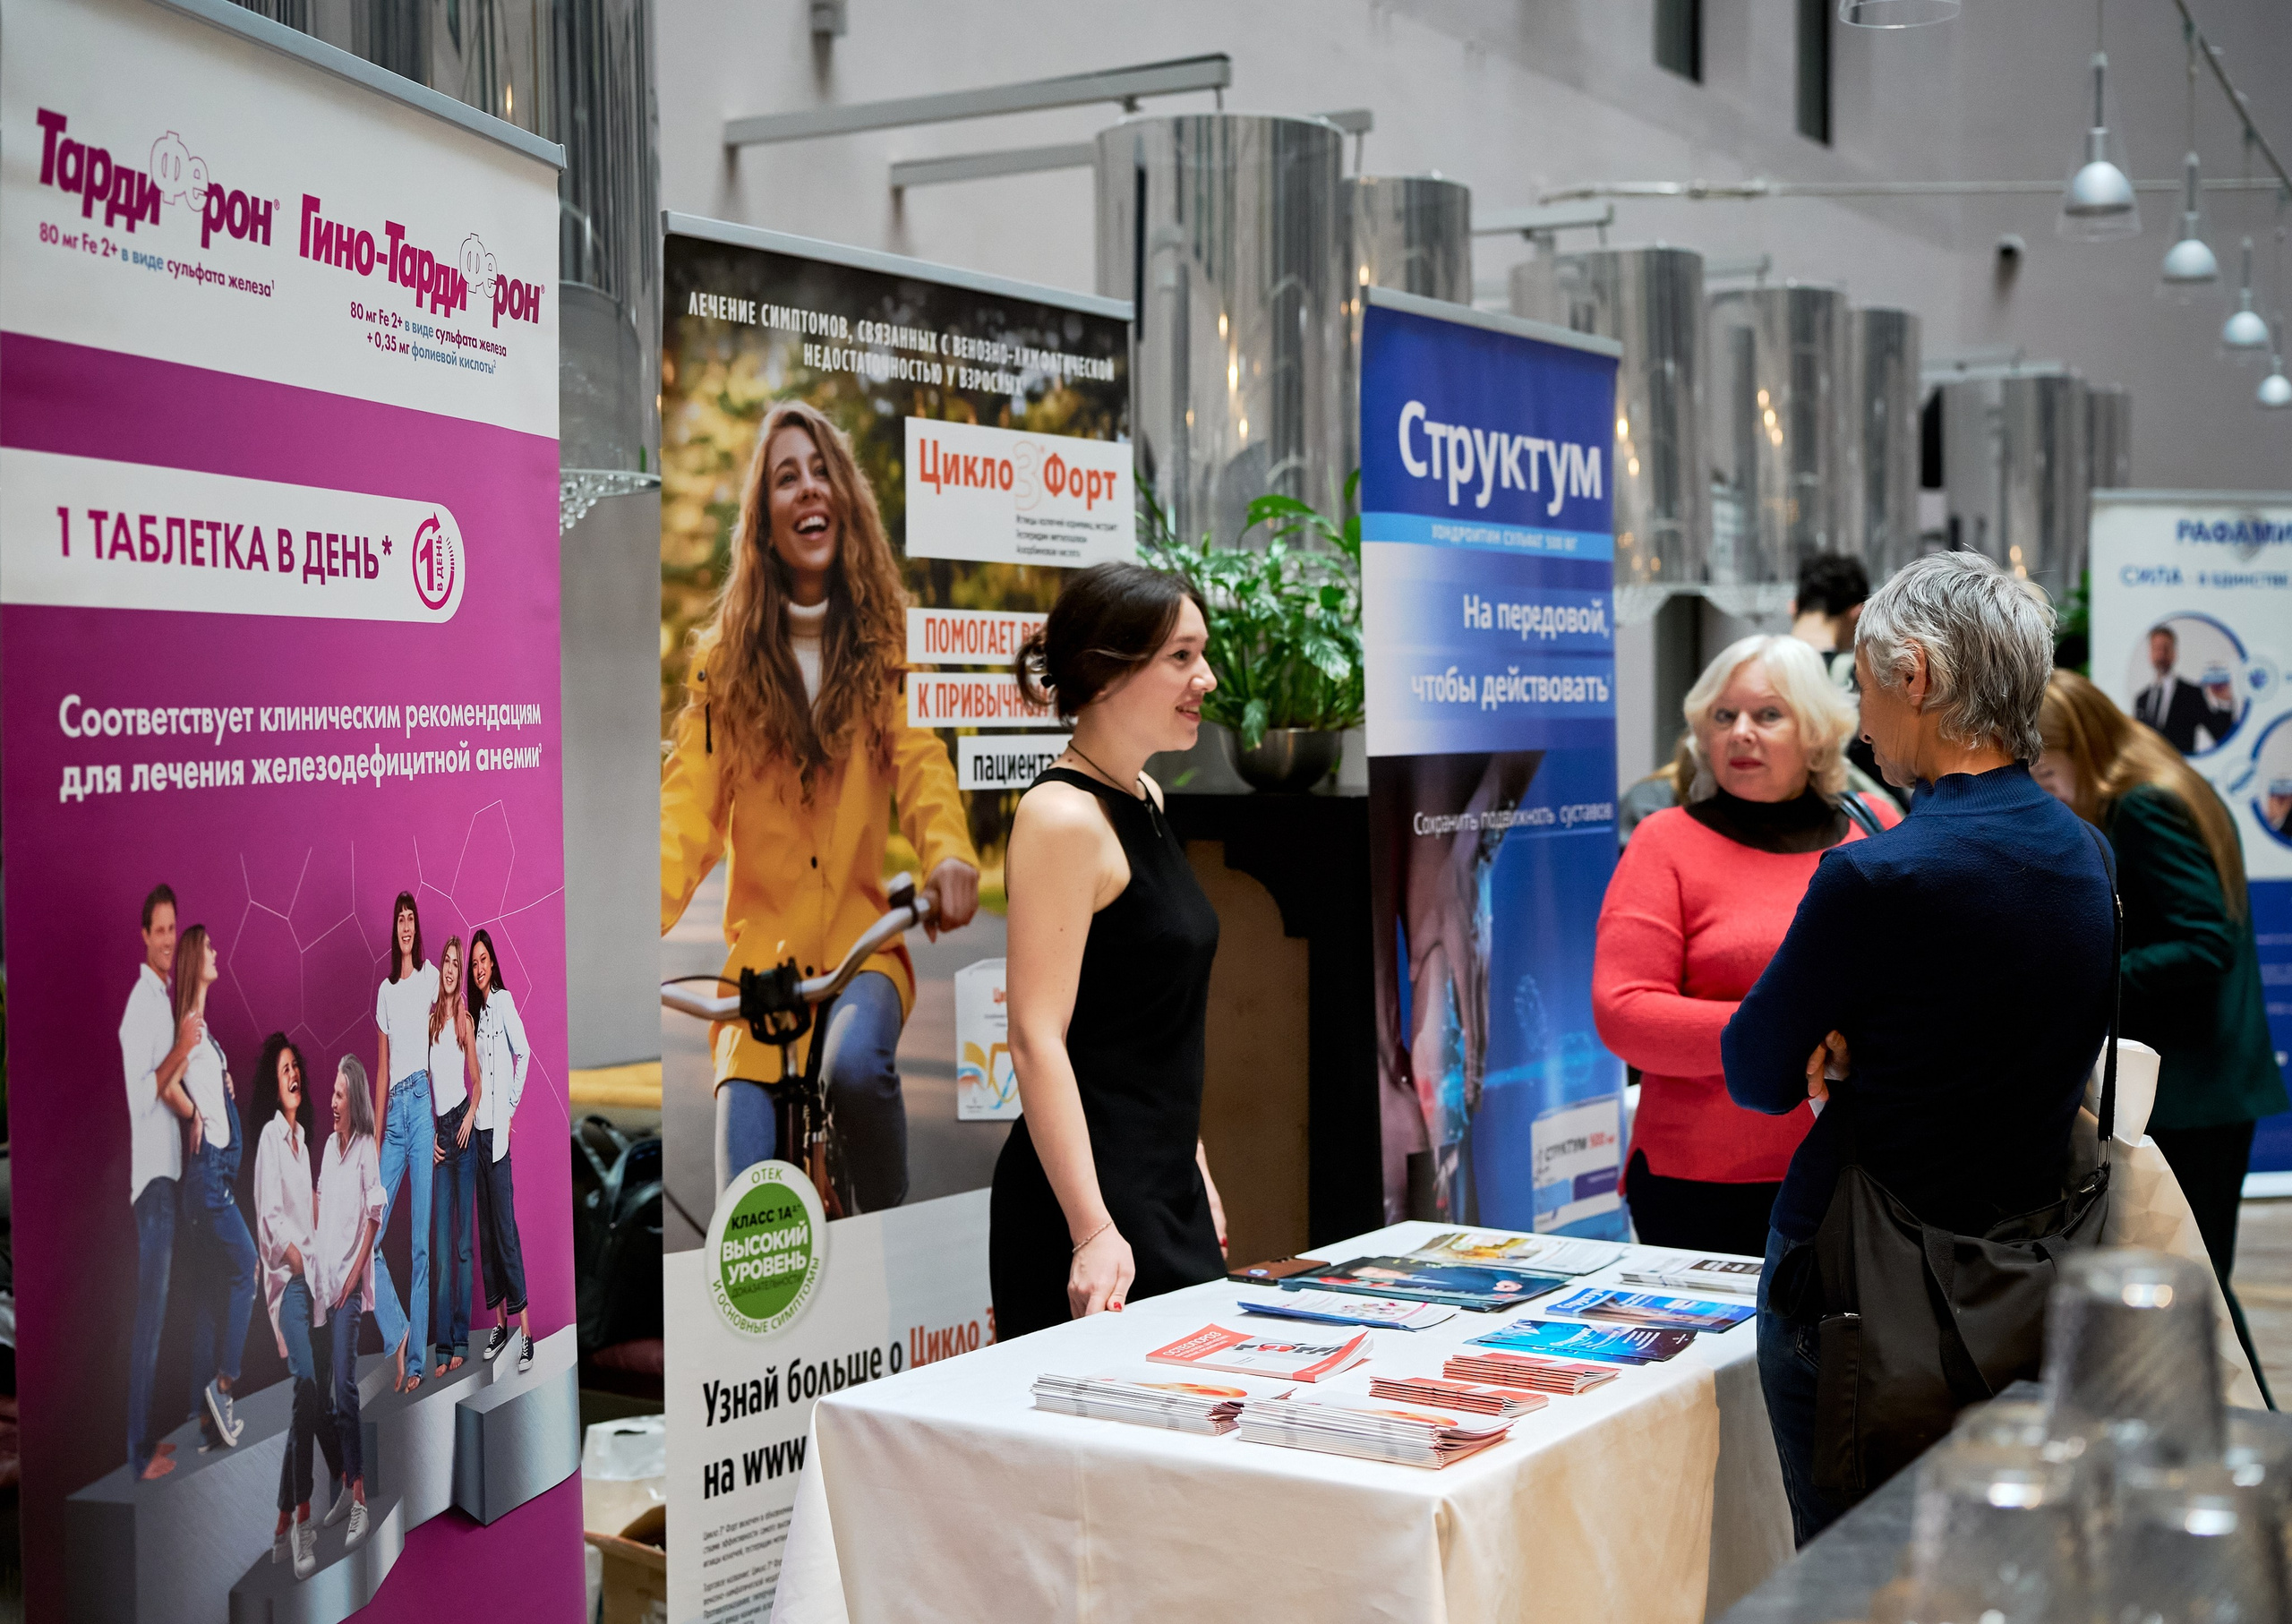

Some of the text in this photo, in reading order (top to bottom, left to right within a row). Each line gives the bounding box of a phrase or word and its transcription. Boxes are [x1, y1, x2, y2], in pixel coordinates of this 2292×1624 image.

[39, 222, 59, 244] 80
[62, 234, 78, 250] мг
[81, 233, 98, 254] Fe
[101, 237, 118, 257] 2+
[121, 248, 129, 261] в
[132, 251, 164, 271] виде
[167, 260, 226, 286] сульфата
[350, 302, 507, 357] 80 мг Fe 2+ в виде сульфата железа
[688, 292, 757, 324] ЛЕЧЕНИЕ
[761, 304, 853, 344] СИМПТОМОВ,
[857, 320, 937, 354] СВЯЗАННЫХ
[941, 334, 949, 355] С
[374, 331, 397, 352] 0,35
[398, 341, 410, 355] мг
[411, 341, 457, 366] фолиевой
[804, 344, 942, 385] НЕДОСТАТОЧНОСТЬЮ
[946, 365, 955, 387] У
[919, 438, 1014, 494] Цикло
[1043, 452, 1116, 510] Форт
[1398, 400, 1603, 517] Структум
[56, 506, 71, 557] 1
[87, 509, 269, 572] ТАБЛЕТКА
[277, 528, 295, 574] В
[436, 535, 444, 579] ДЕНЬ
[420, 538, 434, 591] 1
[925, 618, 1015, 654] ПОМОГАЕТ
[1463, 594, 1610, 640] На передовой,
[918, 683, 929, 718] К
[1411, 665, 1610, 711] чтобы действовать
[59, 694, 542, 746] Соответствует клиническим рекомендациям
[59, 765, 122, 803] для
[131, 760, 244, 792] лечения
[252, 740, 470, 788] железодефицитной
[973, 754, 1062, 784] пациента
[751, 1167, 783, 1184] ОТЕК
[722, 1220, 808, 1262] ВЫСОКИЙ
[731, 1209, 775, 1230] КЛАСС
[727, 1250, 808, 1286] УРОВЕНЬ
[713, 1257, 820, 1334] И ОСНОВНЫЕ СИМПТОМЫ
[1162, 1331, 1222, 1356] ОСТЕОПОРОЗ
[702, 1365, 779, 1427] Узнай
[787, 1346, 882, 1404] больше
[890, 1341, 903, 1374] о
[910, 1320, 979, 1369] Цикло
[704, 1458, 734, 1500] на
